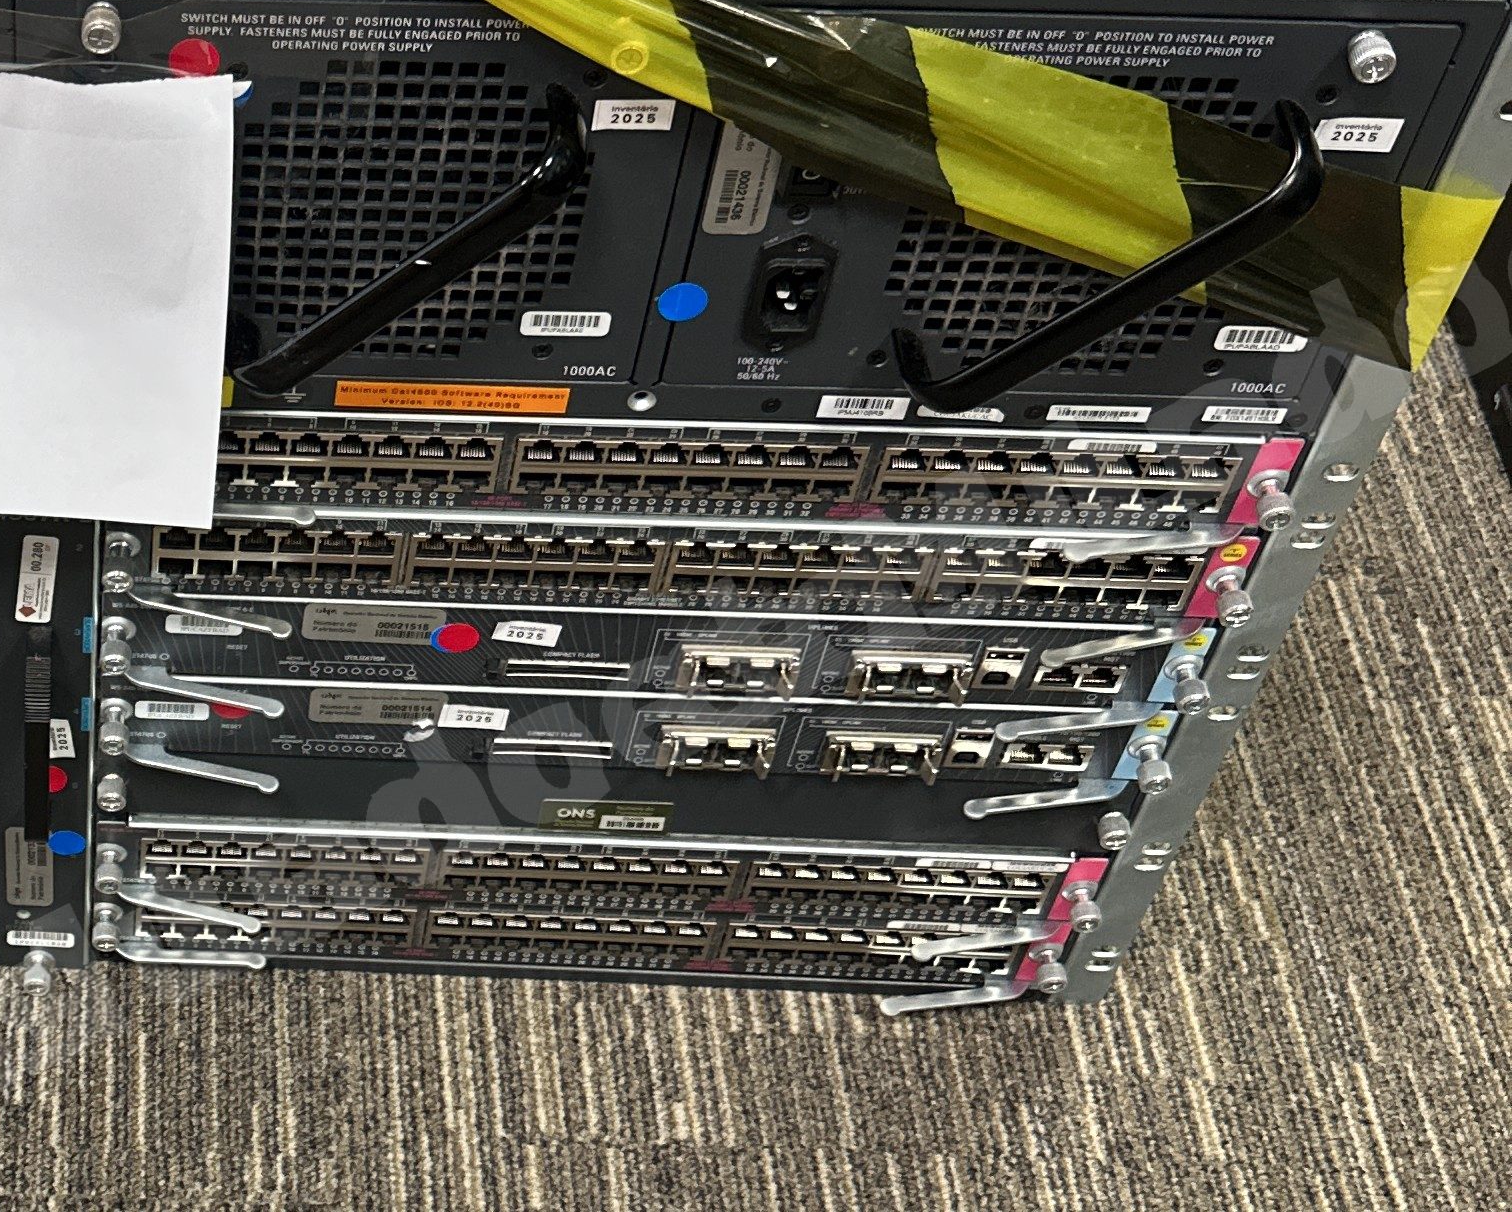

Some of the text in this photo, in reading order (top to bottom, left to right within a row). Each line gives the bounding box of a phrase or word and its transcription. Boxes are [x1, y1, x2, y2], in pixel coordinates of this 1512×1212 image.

[180, 13, 483, 28] SWITCH MUST BE IN OFF POSITION TO INSTALL
[240, 27, 308, 38] FASTENERS
[311, 28, 346, 39] MUST
[349, 28, 365, 39] BE
[367, 29, 402, 40] FULLY
[404, 29, 463, 41] ENGAGED
[466, 30, 503, 42] PRIOR
[506, 31, 521, 42] TO
[968, 29, 1275, 46] MUST BE IN OFF POSITION TO INSTALL POWER
[272, 41, 433, 53] OPERATING POWER SUPPLY
[1047, 43, 1263, 59] MUST BE FULLY ENGAGED PRIOR TO
[1076, 56, 1170, 68] POWER SUPPLY
[610, 113, 657, 125] 2025
[1331, 131, 1380, 143] 2025
[562, 364, 617, 377] 1000AC
[340, 386, 387, 394] Minimum
[440, 388, 492, 397] Software
[495, 390, 565, 400] Requirement
[1230, 382, 1286, 394] 1000AC
[506, 630, 544, 641] 2025
[456, 714, 492, 723] 2025
[57, 726, 69, 752] 2025
[556, 807, 597, 820] ONS
